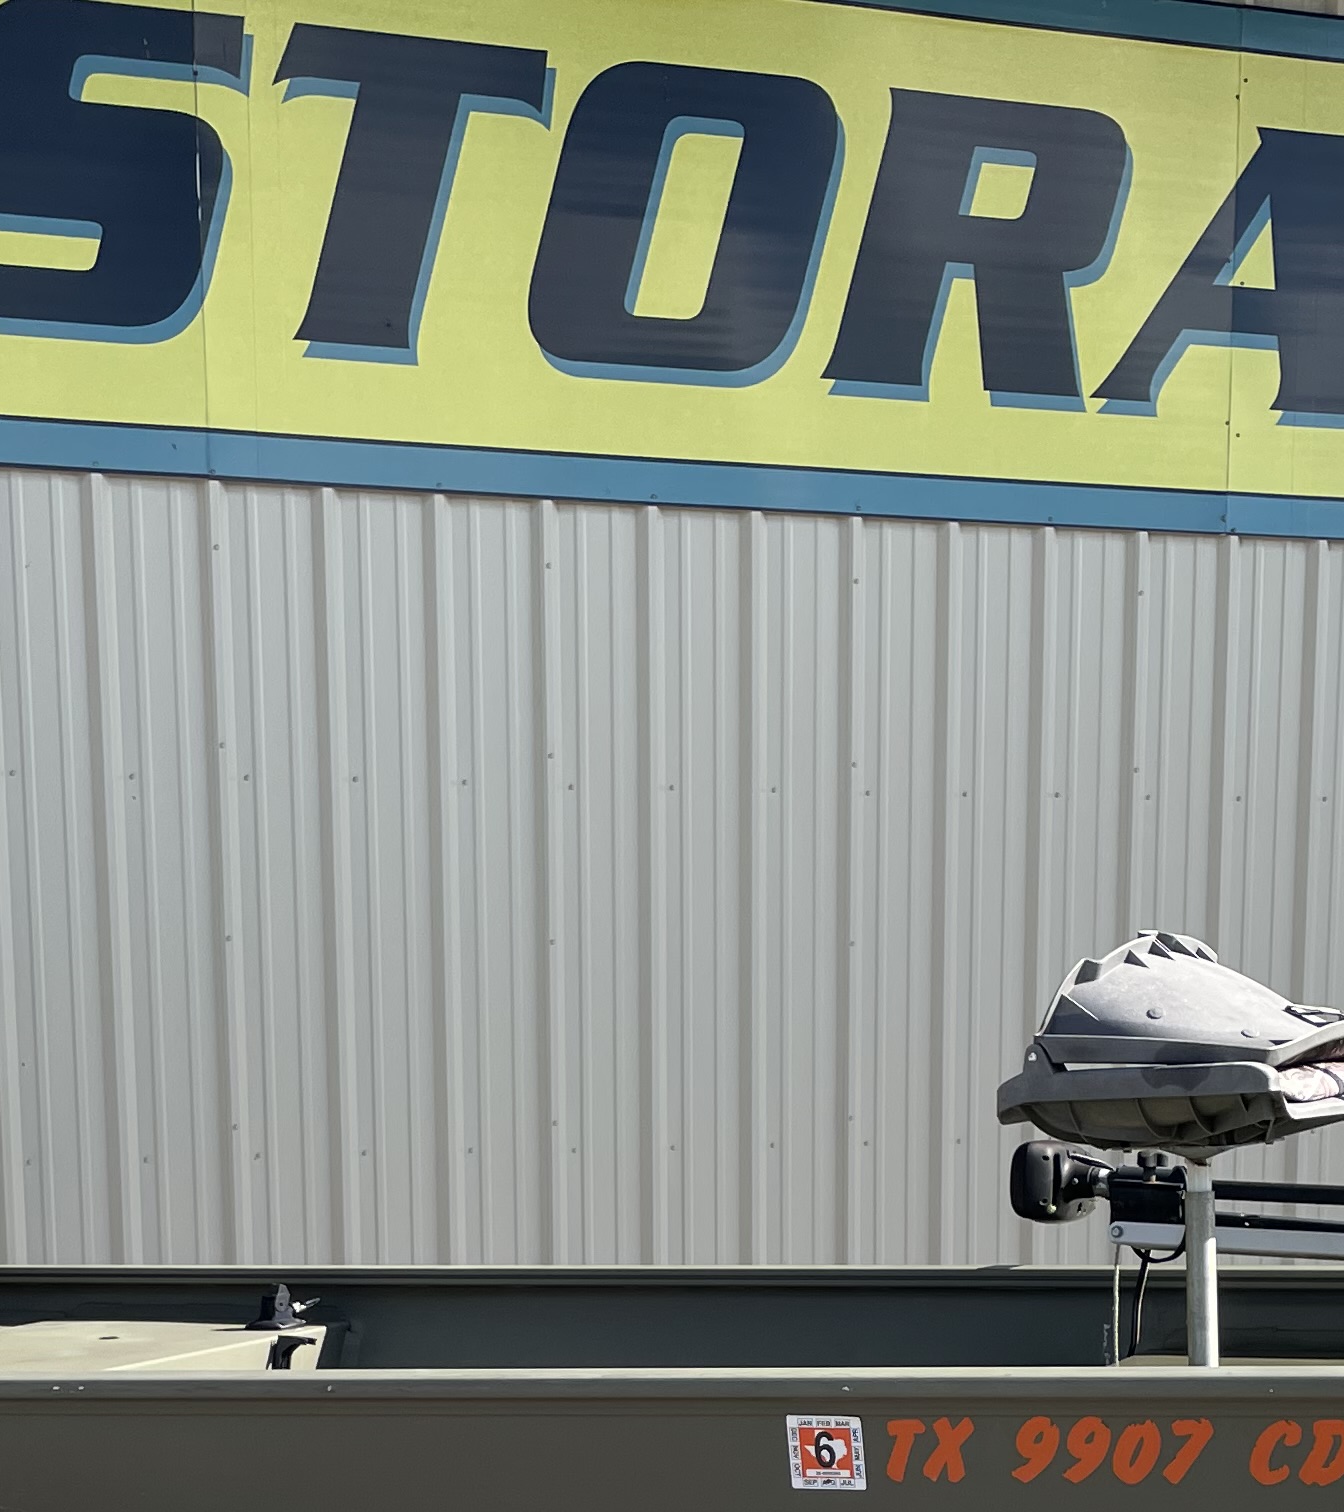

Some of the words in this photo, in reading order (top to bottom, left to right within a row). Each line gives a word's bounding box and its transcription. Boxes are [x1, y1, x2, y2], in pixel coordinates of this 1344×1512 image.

[815, 1431, 836, 1468] 6
[886, 1416, 975, 1483] TX
[1012, 1416, 1215, 1486] 9907
